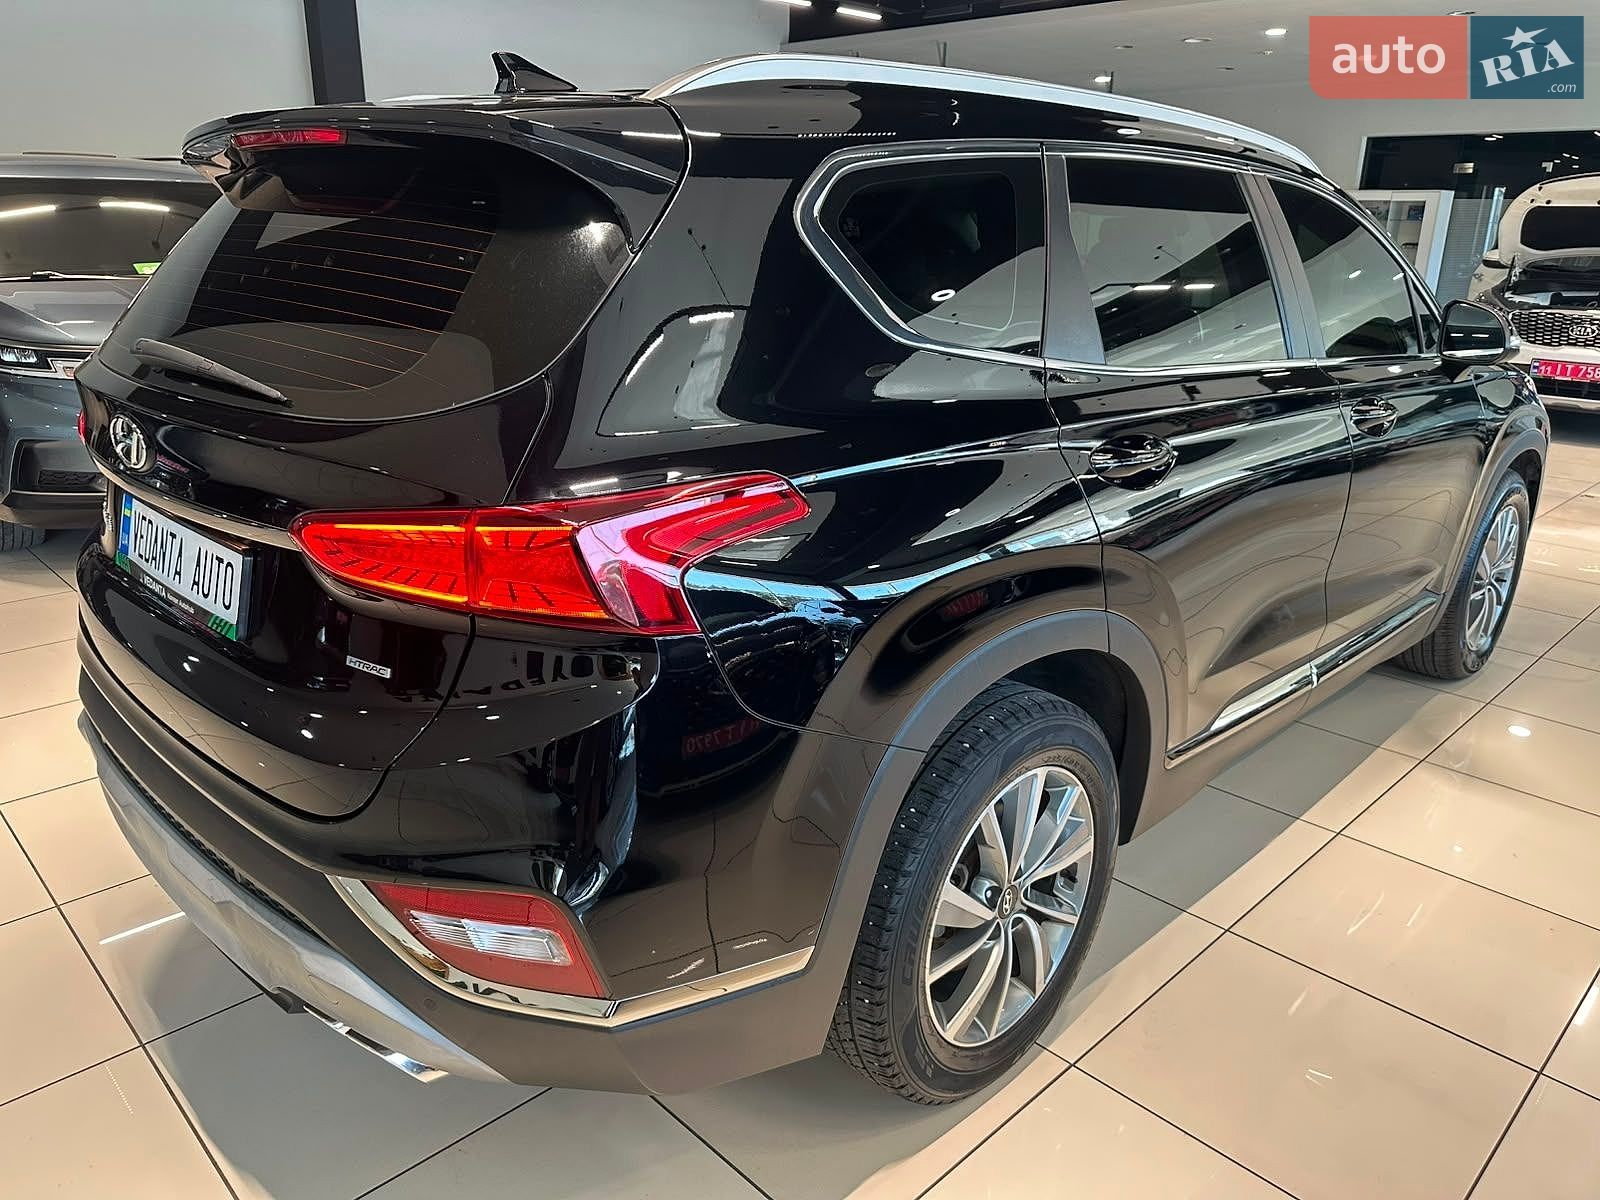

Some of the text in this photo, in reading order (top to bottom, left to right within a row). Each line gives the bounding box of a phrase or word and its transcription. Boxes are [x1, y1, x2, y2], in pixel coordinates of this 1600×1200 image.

[1573, 325, 1592, 336] KIA
[133, 510, 234, 611] VEDANTA AUTO
[348, 657, 388, 677] HTRAC
